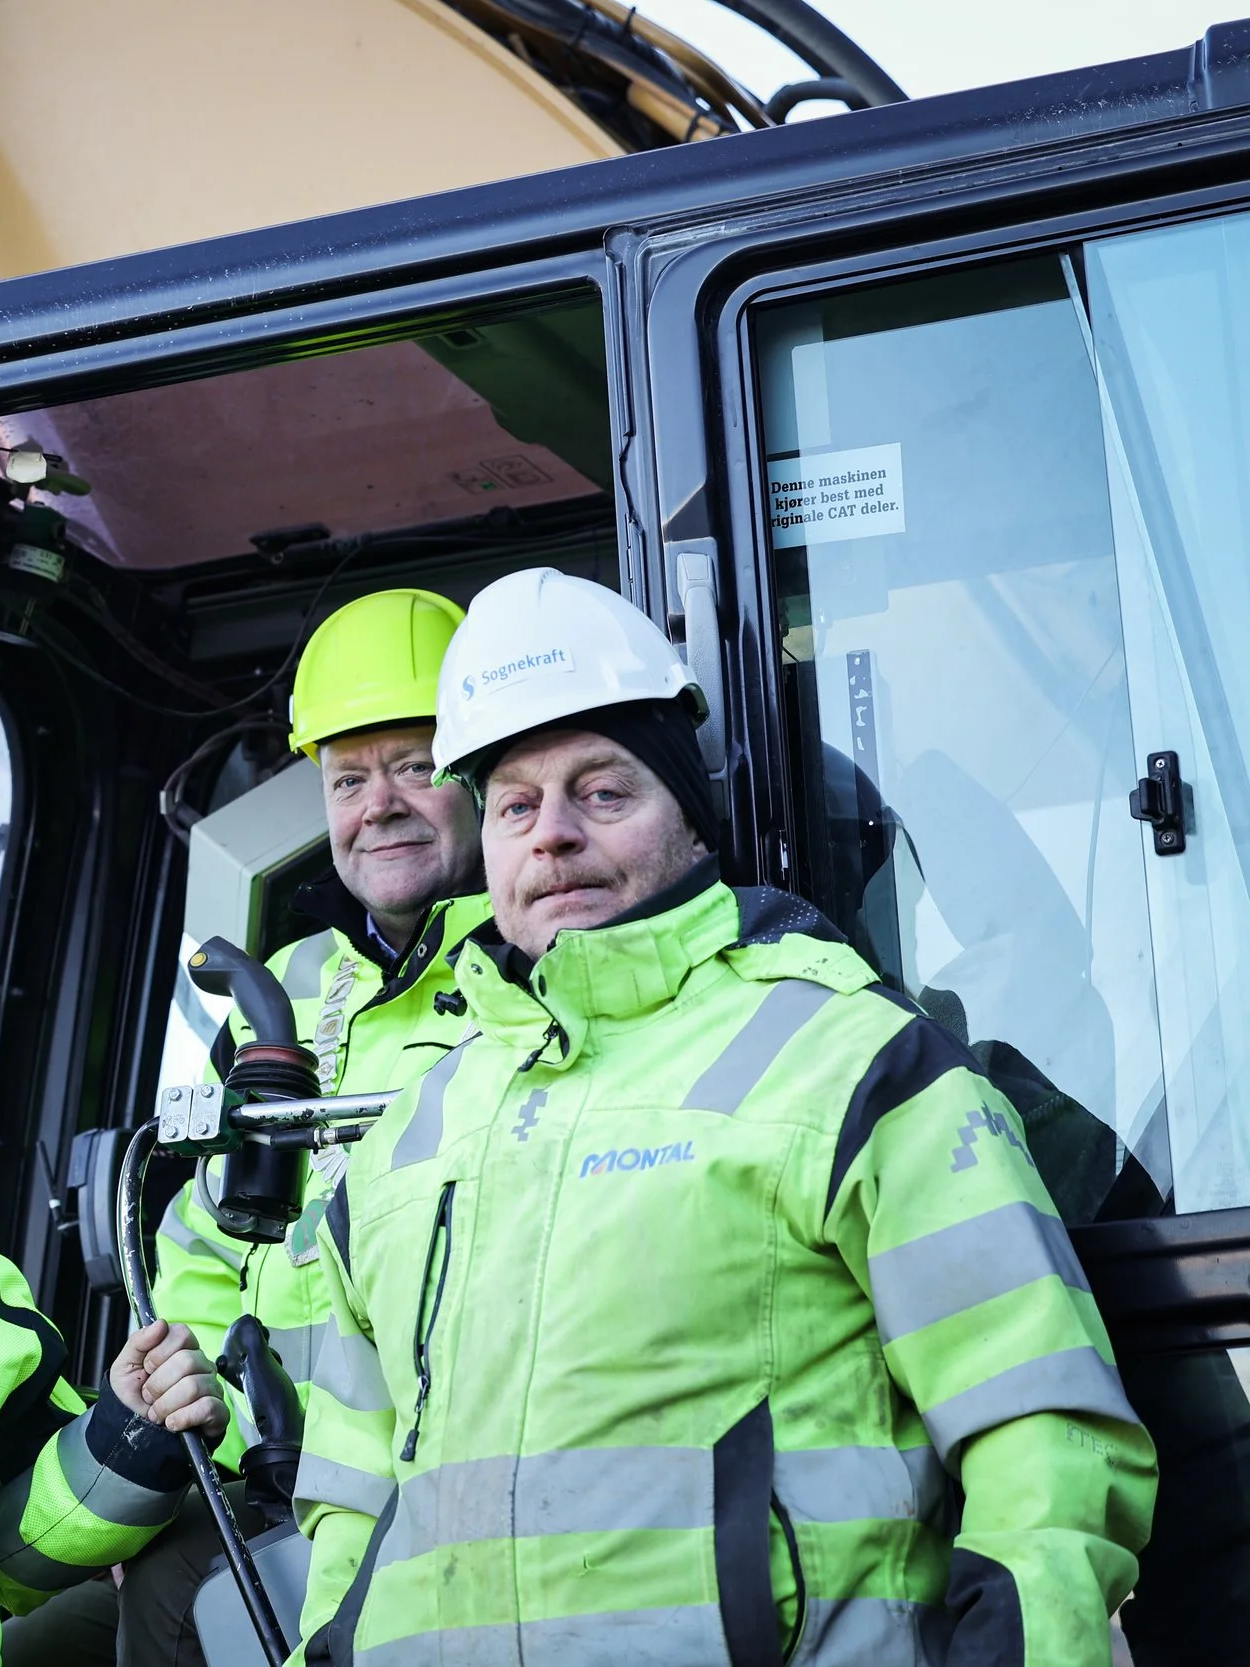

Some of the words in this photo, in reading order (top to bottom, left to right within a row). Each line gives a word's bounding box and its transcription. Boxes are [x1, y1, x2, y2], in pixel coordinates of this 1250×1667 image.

[771, 478, 815, 494] Denne
[818, 469, 887, 488] maskinen
[775, 496, 817, 512] kjører
[821, 489, 851, 504] best
[853, 484, 884, 499] med
[770, 510, 824, 529] riginale
[828, 504, 857, 520] CAT
[860, 501, 899, 515] deler.
[481, 648, 566, 686] Sognekraft
[579, 1140, 695, 1179] MONTAL
